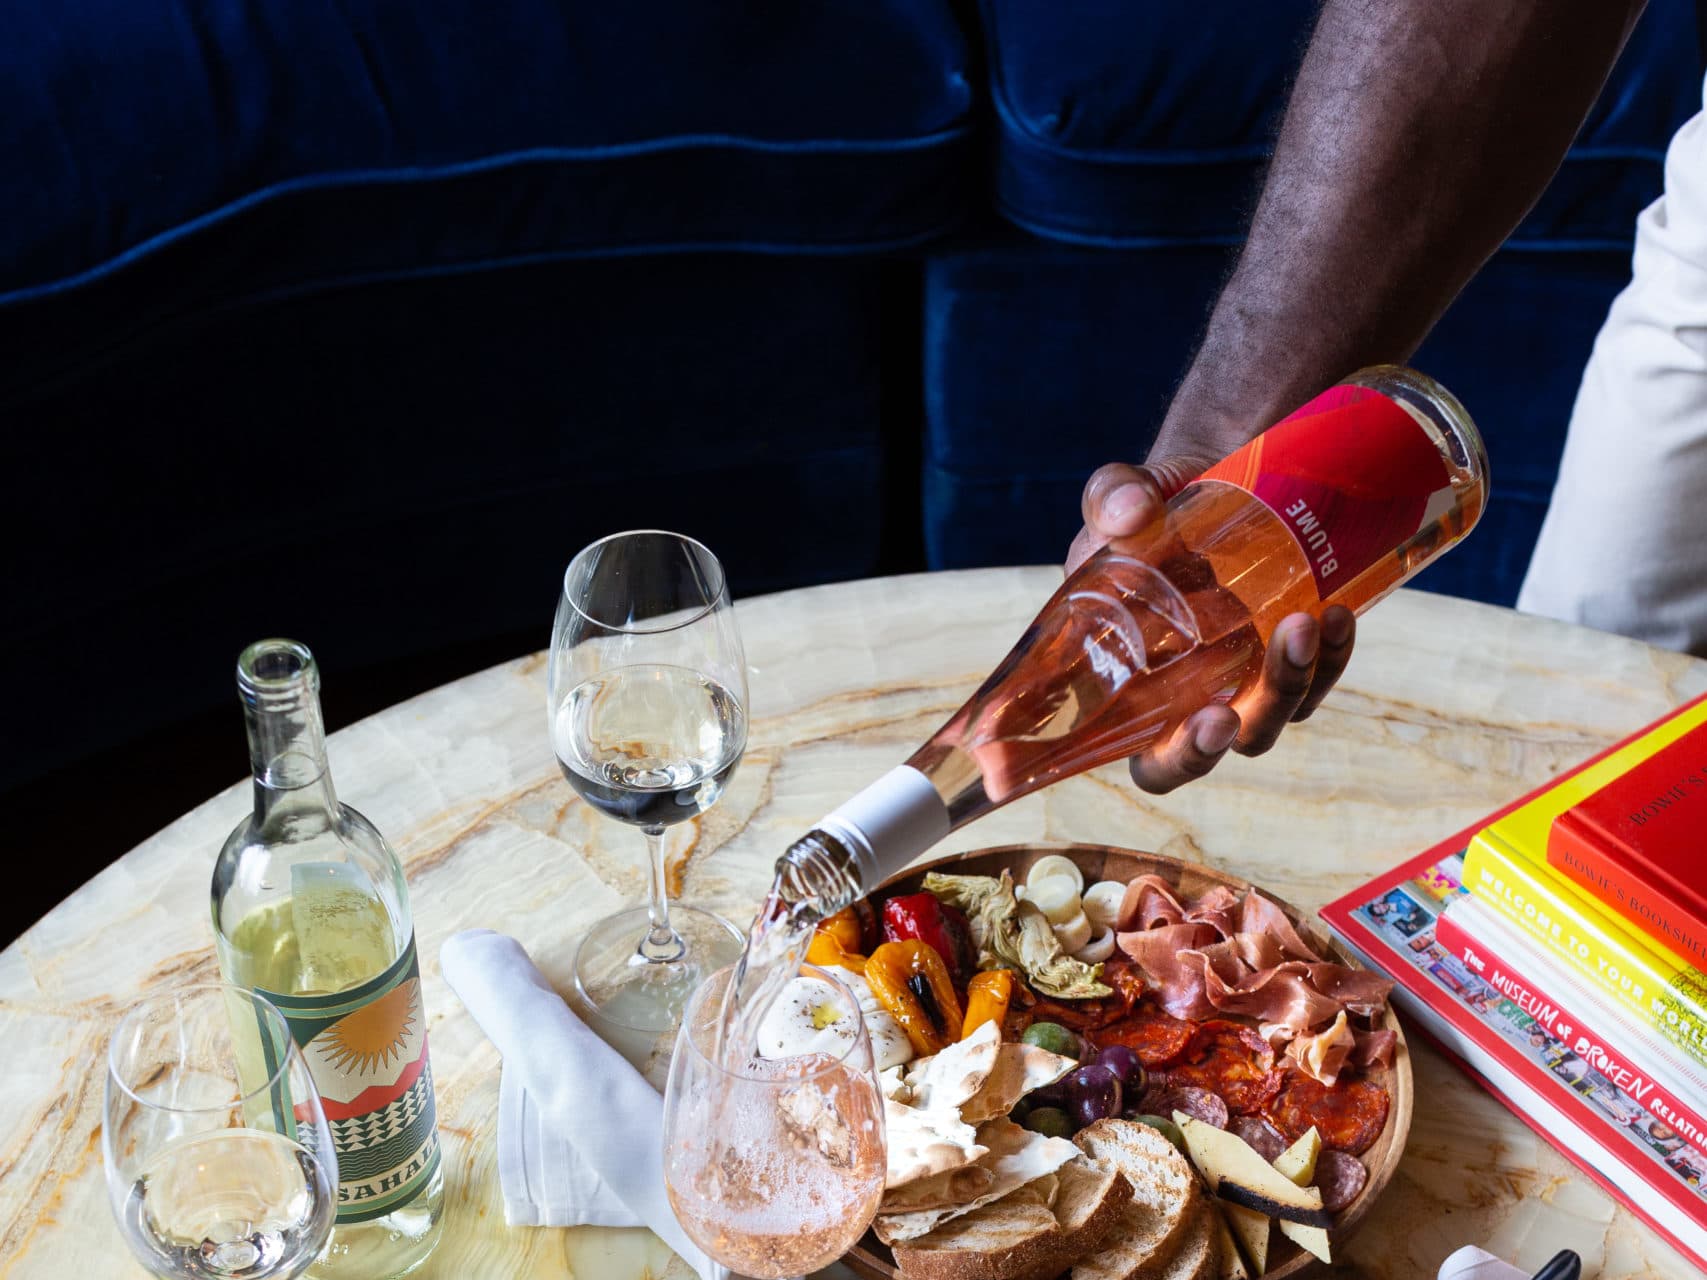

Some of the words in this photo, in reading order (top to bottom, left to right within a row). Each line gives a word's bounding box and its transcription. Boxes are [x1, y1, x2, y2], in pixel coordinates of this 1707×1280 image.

[1285, 499, 1338, 578] BLUME
[1481, 867, 1561, 937] WELCOME
[1569, 935, 1590, 958] TO
[1598, 956, 1644, 999] YOUR
[1463, 947, 1486, 972] THE
[1491, 969, 1560, 1029] MUSEUM
[1557, 1022, 1573, 1040] OF
[1574, 1036, 1654, 1100] BROKEN
